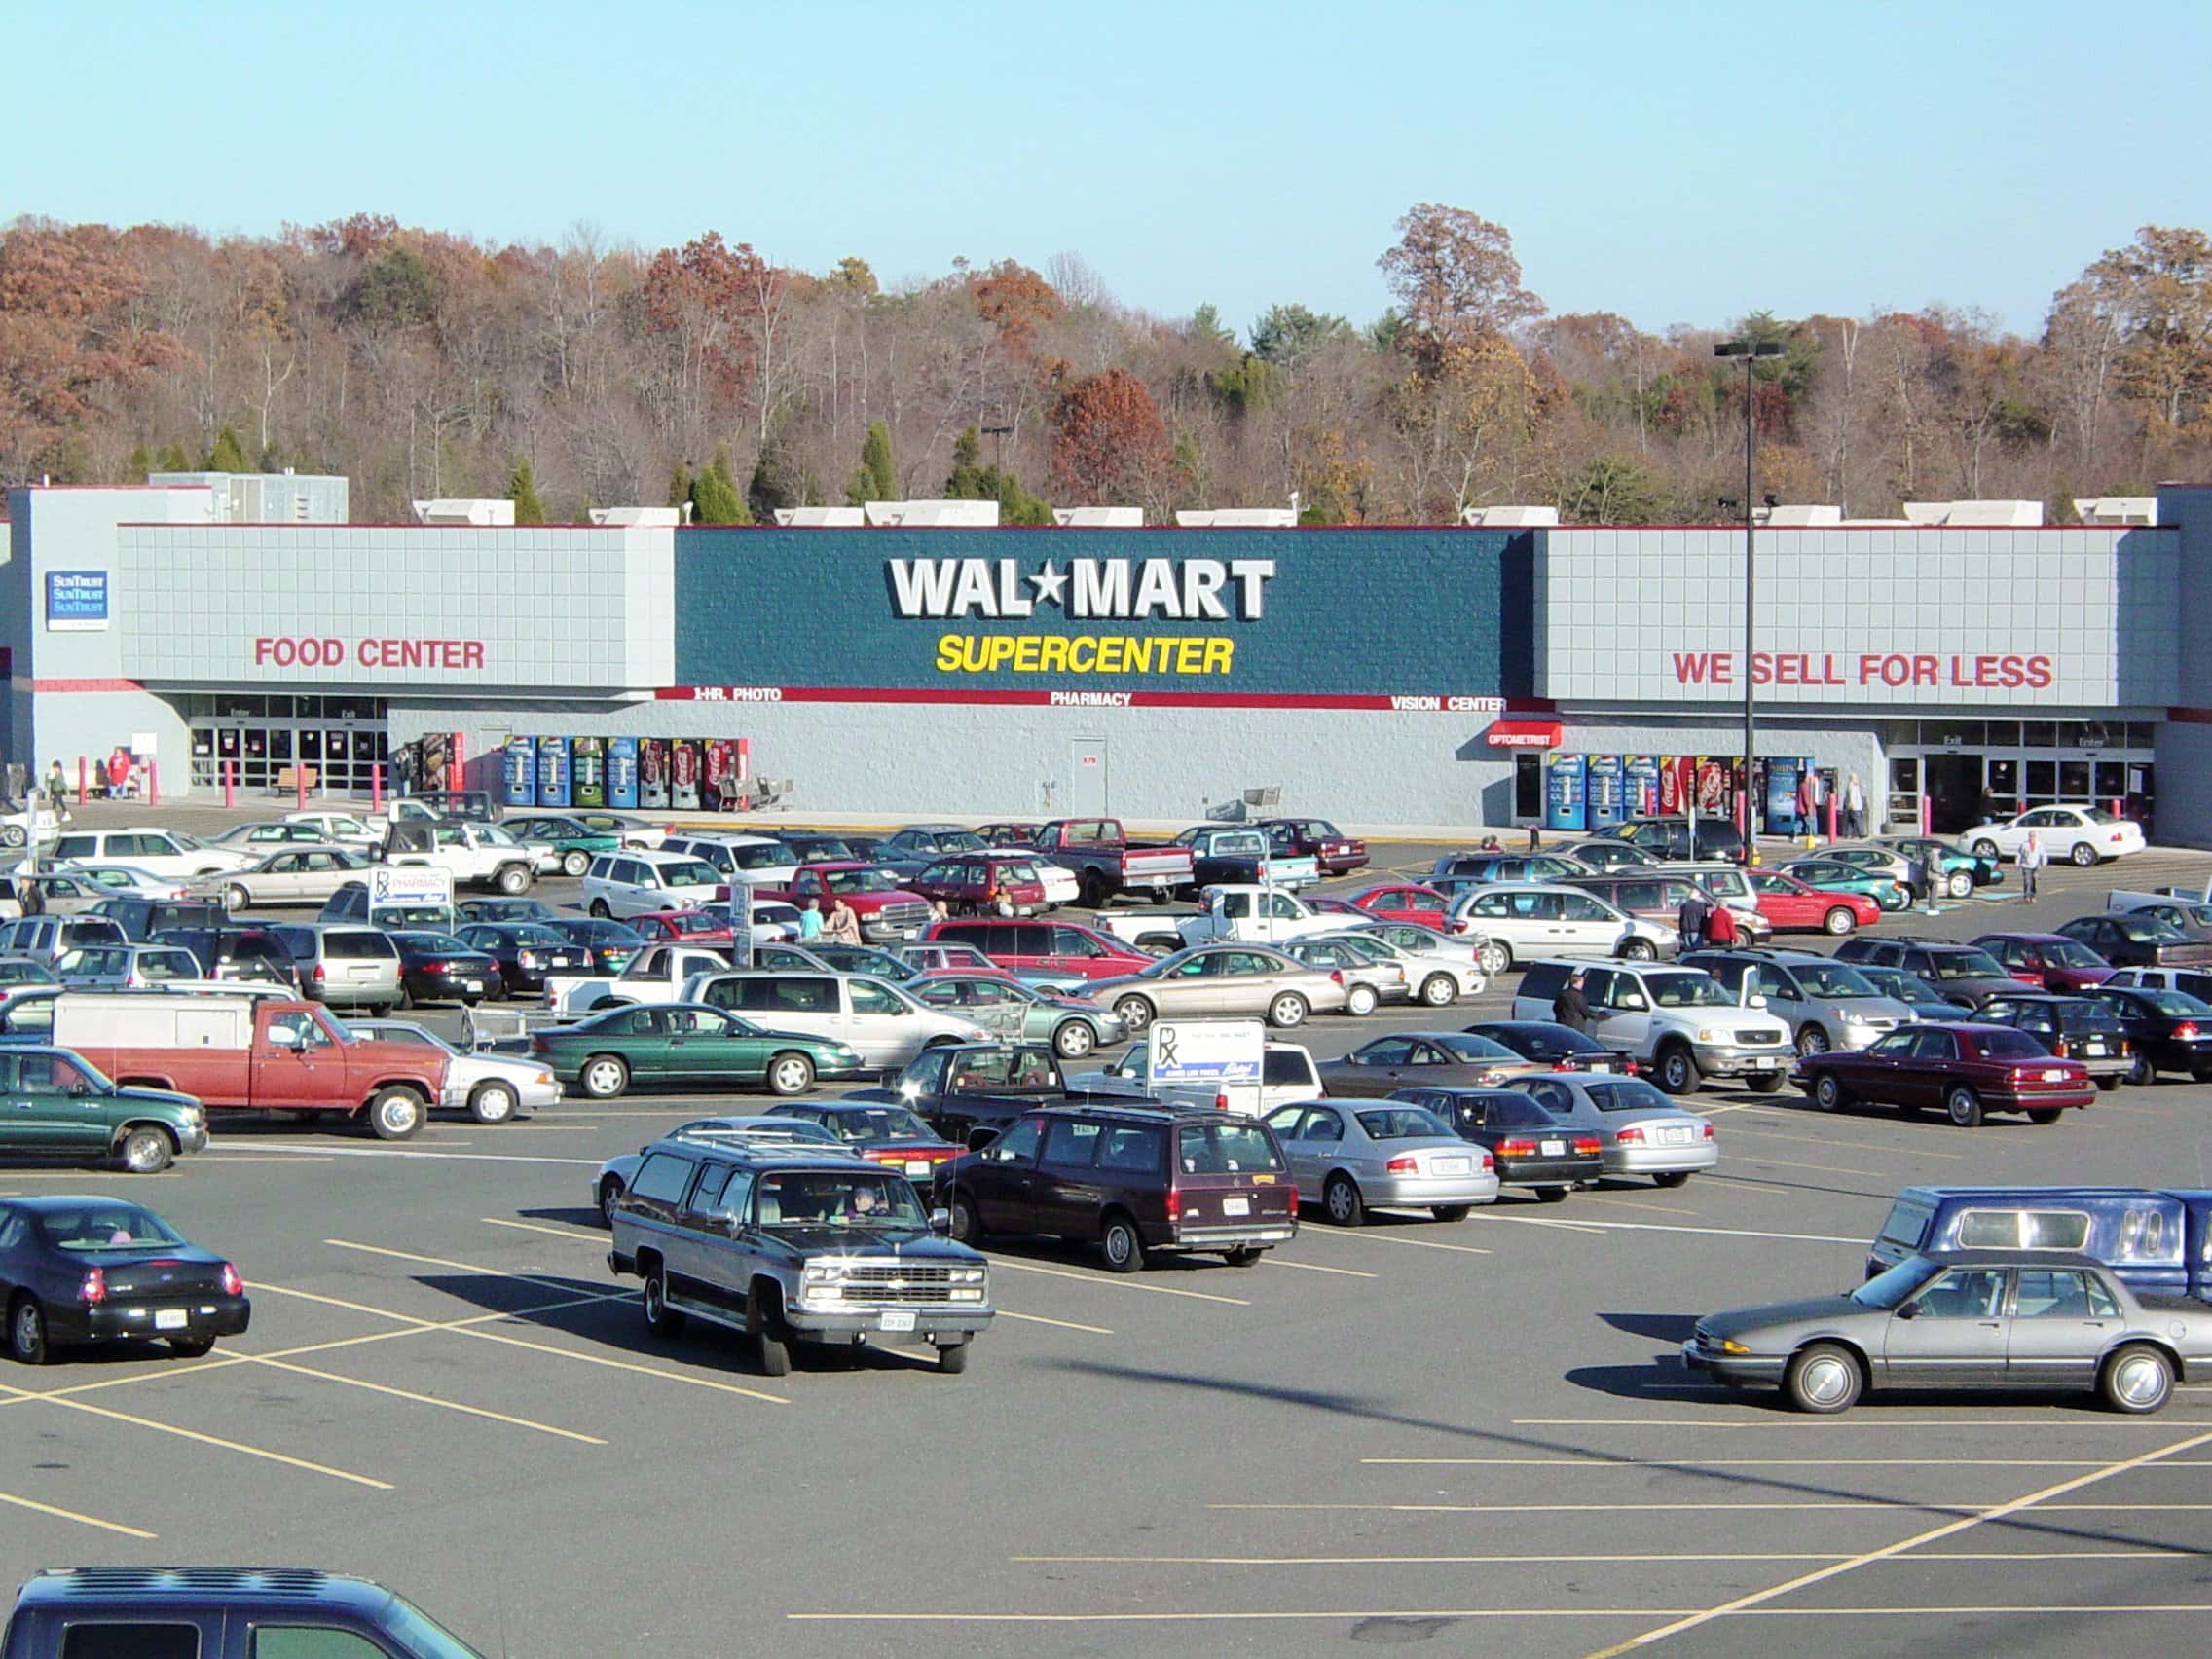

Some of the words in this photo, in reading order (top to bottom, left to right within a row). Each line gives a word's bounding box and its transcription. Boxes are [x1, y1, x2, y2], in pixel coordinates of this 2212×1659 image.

[255, 638, 345, 667] FOOD
[357, 639, 485, 669] CENTER
[935, 635, 1235, 674] SUPERCENTER
[1673, 653, 1733, 683] WE
[1751, 653, 1846, 685] SELL
[1859, 654, 1938, 686] FOR
[1951, 655, 2053, 688] LESS
[733, 687, 782, 701] PHOTO
[1050, 692, 1132, 706] PHARMACY
[1390, 696, 1441, 711] VISION
[1448, 697, 1507, 712] CENTER
[1488, 734, 1551, 746] OPTOMETRIST
